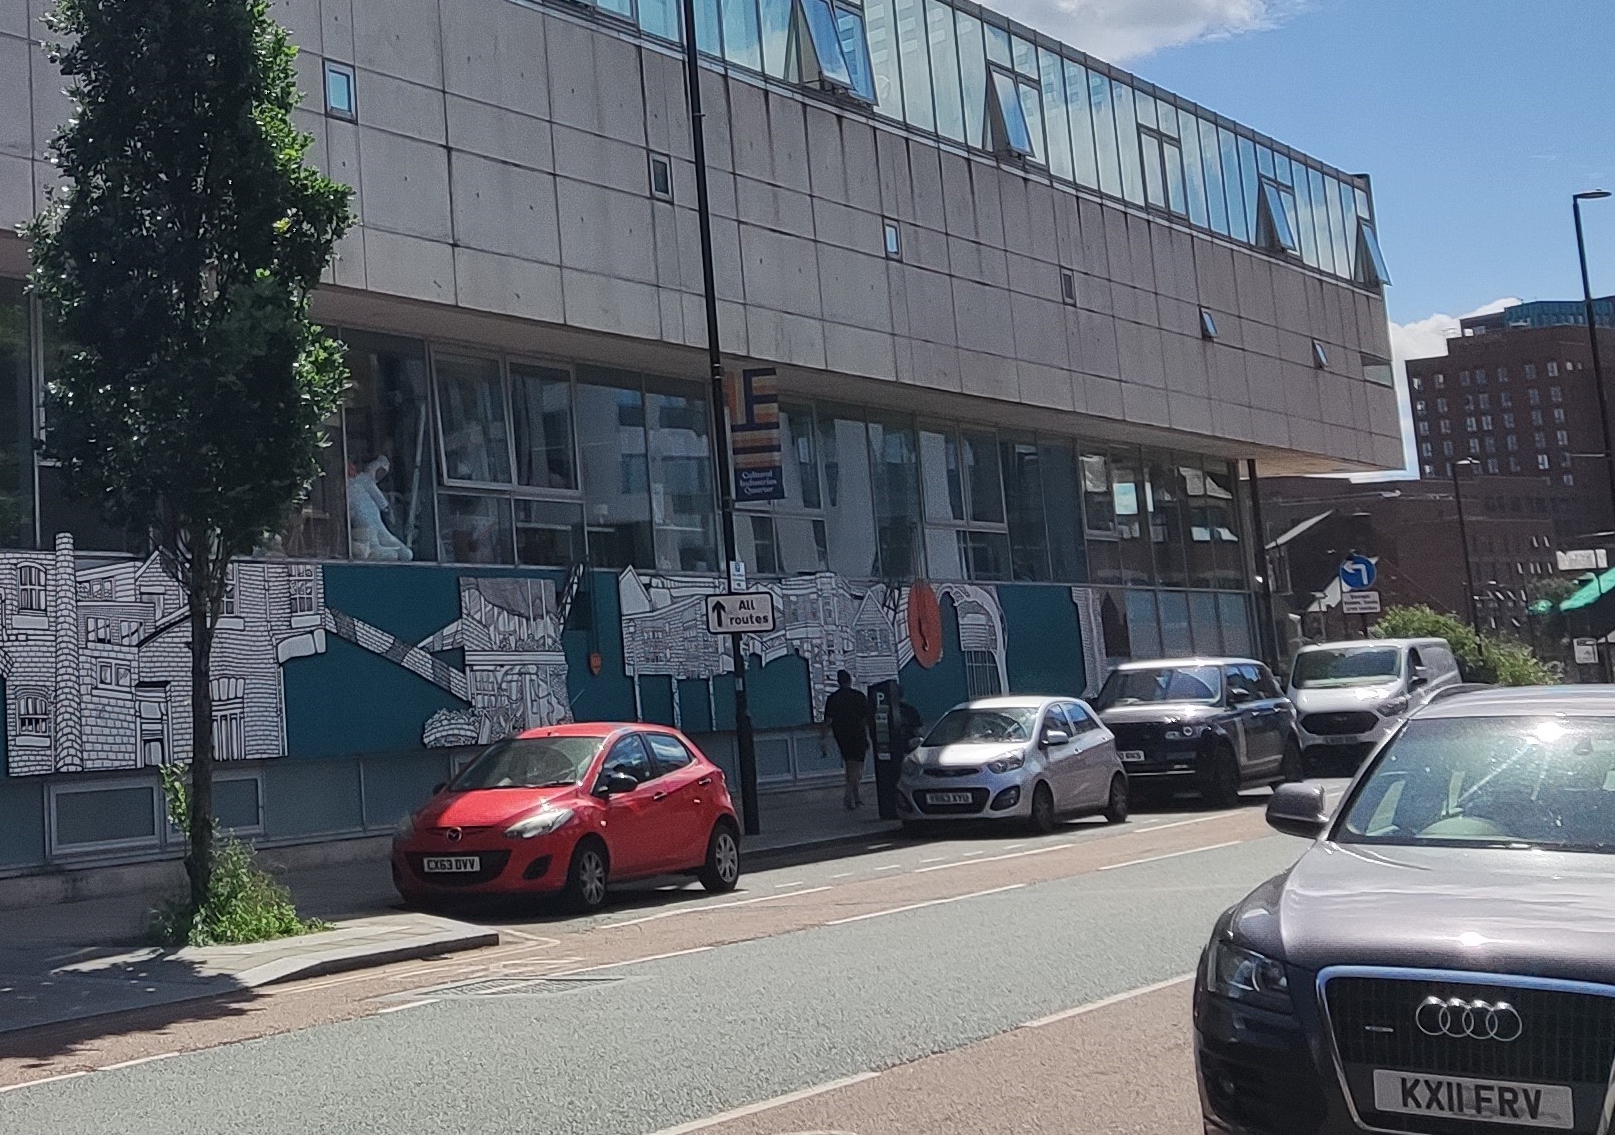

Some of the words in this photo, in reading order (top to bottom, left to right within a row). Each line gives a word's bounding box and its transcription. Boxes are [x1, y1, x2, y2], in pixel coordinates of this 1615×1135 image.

[738, 599, 756, 611] All
[729, 613, 769, 625] routes
[876, 692, 885, 707] P
[454, 858, 475, 870] DVV
[1400, 1077, 1464, 1113] KX11
[1474, 1084, 1542, 1119] FRV
